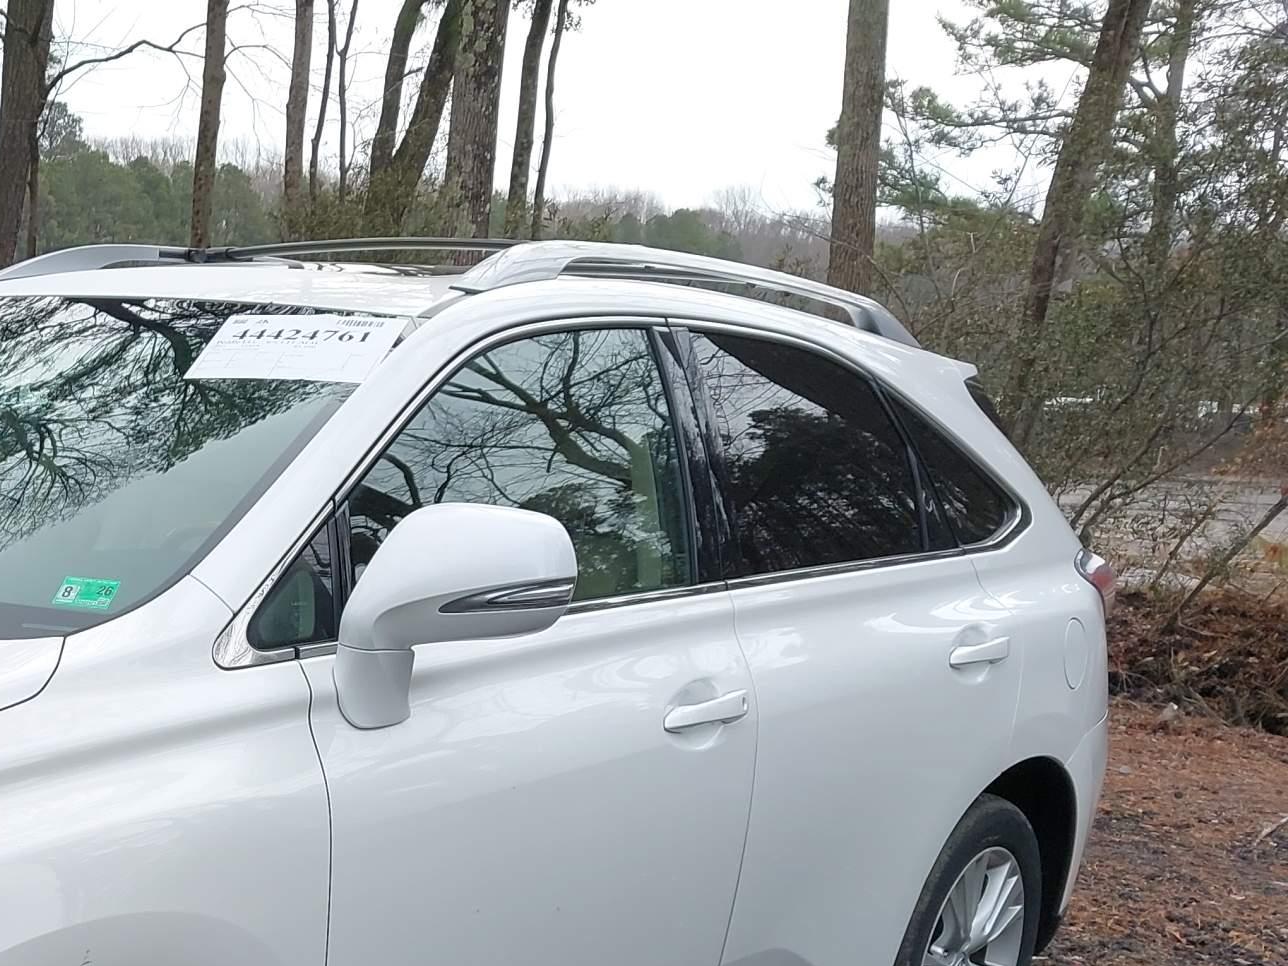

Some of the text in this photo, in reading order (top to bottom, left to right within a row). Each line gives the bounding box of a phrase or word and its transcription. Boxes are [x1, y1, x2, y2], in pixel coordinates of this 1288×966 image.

[232, 328, 372, 343] 44424761
[62, 586, 73, 598] 8
[96, 585, 114, 596] 26
